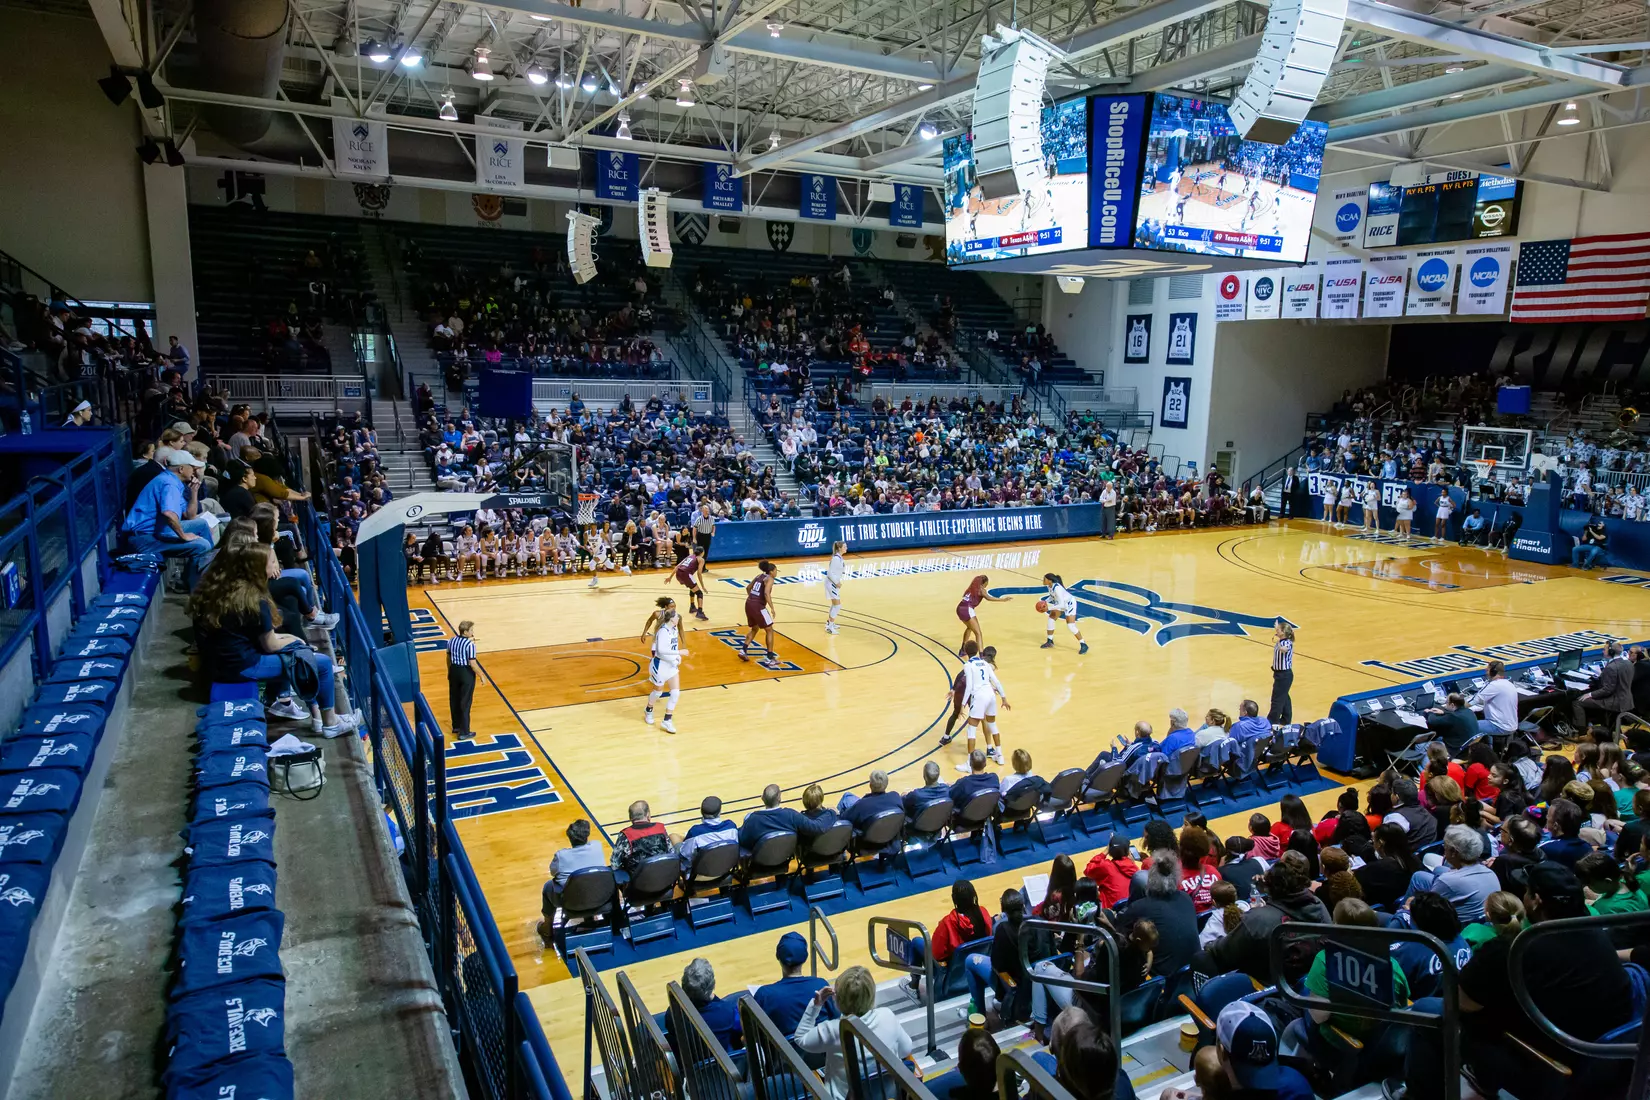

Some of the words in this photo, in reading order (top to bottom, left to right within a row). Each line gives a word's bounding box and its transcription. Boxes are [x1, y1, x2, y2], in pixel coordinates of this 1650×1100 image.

[349, 140, 374, 152] RICE
[489, 157, 512, 168] RICE
[608, 170, 628, 180] RICE
[1100, 101, 1129, 244] ShopRiceU.com
[714, 182, 734, 191] RICE
[1480, 176, 1515, 188] Methodist
[810, 192, 827, 201] RICE
[899, 201, 914, 210] RICE
[1337, 212, 1358, 222] NCAA
[1039, 232, 1050, 240] 9:51
[1368, 224, 1394, 237] RICE
[1215, 233, 1223, 242] 49
[1224, 234, 1239, 243] Texas
[1239, 236, 1253, 245] A&M
[1260, 237, 1271, 245] 9:51
[1274, 238, 1282, 246] 22
[1369, 276, 1402, 285] C-USA
[1420, 274, 1447, 284] NCAA
[1472, 271, 1500, 281] NCAA
[1287, 284, 1315, 292] C-USA
[1326, 278, 1357, 288] C-USA
[1133, 335, 1142, 347] 16
[1176, 334, 1186, 347] 21
[1169, 398, 1181, 411] 22
[508, 496, 541, 506] SPALDING
[840, 525, 856, 541] THE
[858, 523, 878, 541] TRUE
[998, 515, 1023, 531] BEGINS
[1025, 514, 1042, 530] HERE
[798, 528, 826, 543] OWL
[1518, 538, 1540, 546] smart
[1516, 543, 1551, 554] financial
[1358, 652, 1489, 679] TUDOR
[1450, 630, 1630, 663] FIELDHOUSE
[440, 733, 564, 821] RICE
[1181, 874, 1218, 892] NASA
[889, 934, 905, 958] 104
[1334, 952, 1378, 994] 104
